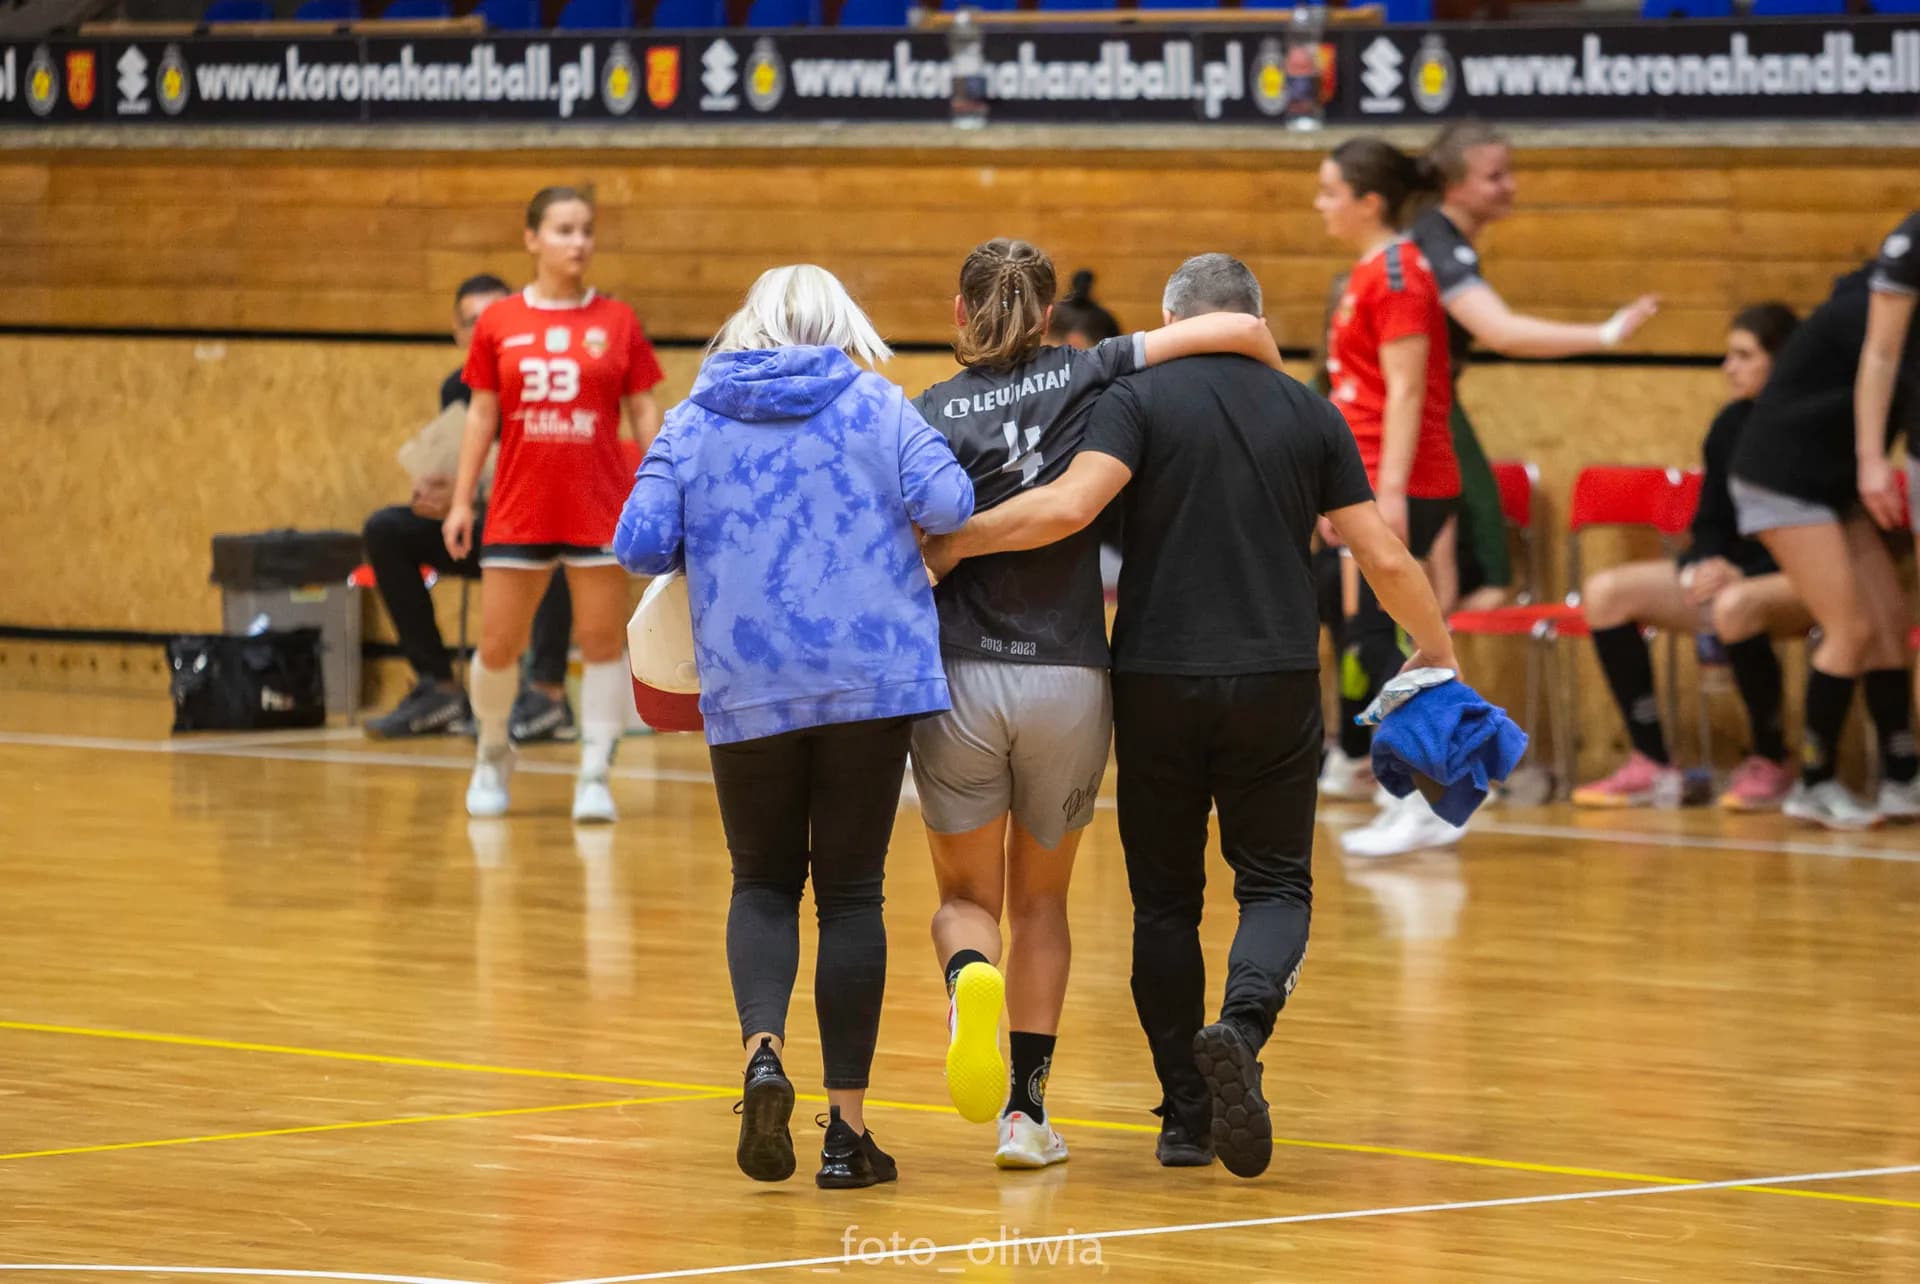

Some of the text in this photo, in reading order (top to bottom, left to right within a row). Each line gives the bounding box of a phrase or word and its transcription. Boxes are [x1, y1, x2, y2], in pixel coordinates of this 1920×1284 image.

[196, 45, 594, 117] www.koronahandball.pl
[792, 41, 1243, 118] www.kornahandball.pl
[519, 357, 580, 402] 33
[1002, 420, 1044, 486] 4
[980, 636, 1002, 652] 2013
[1010, 640, 1036, 656] 2023
